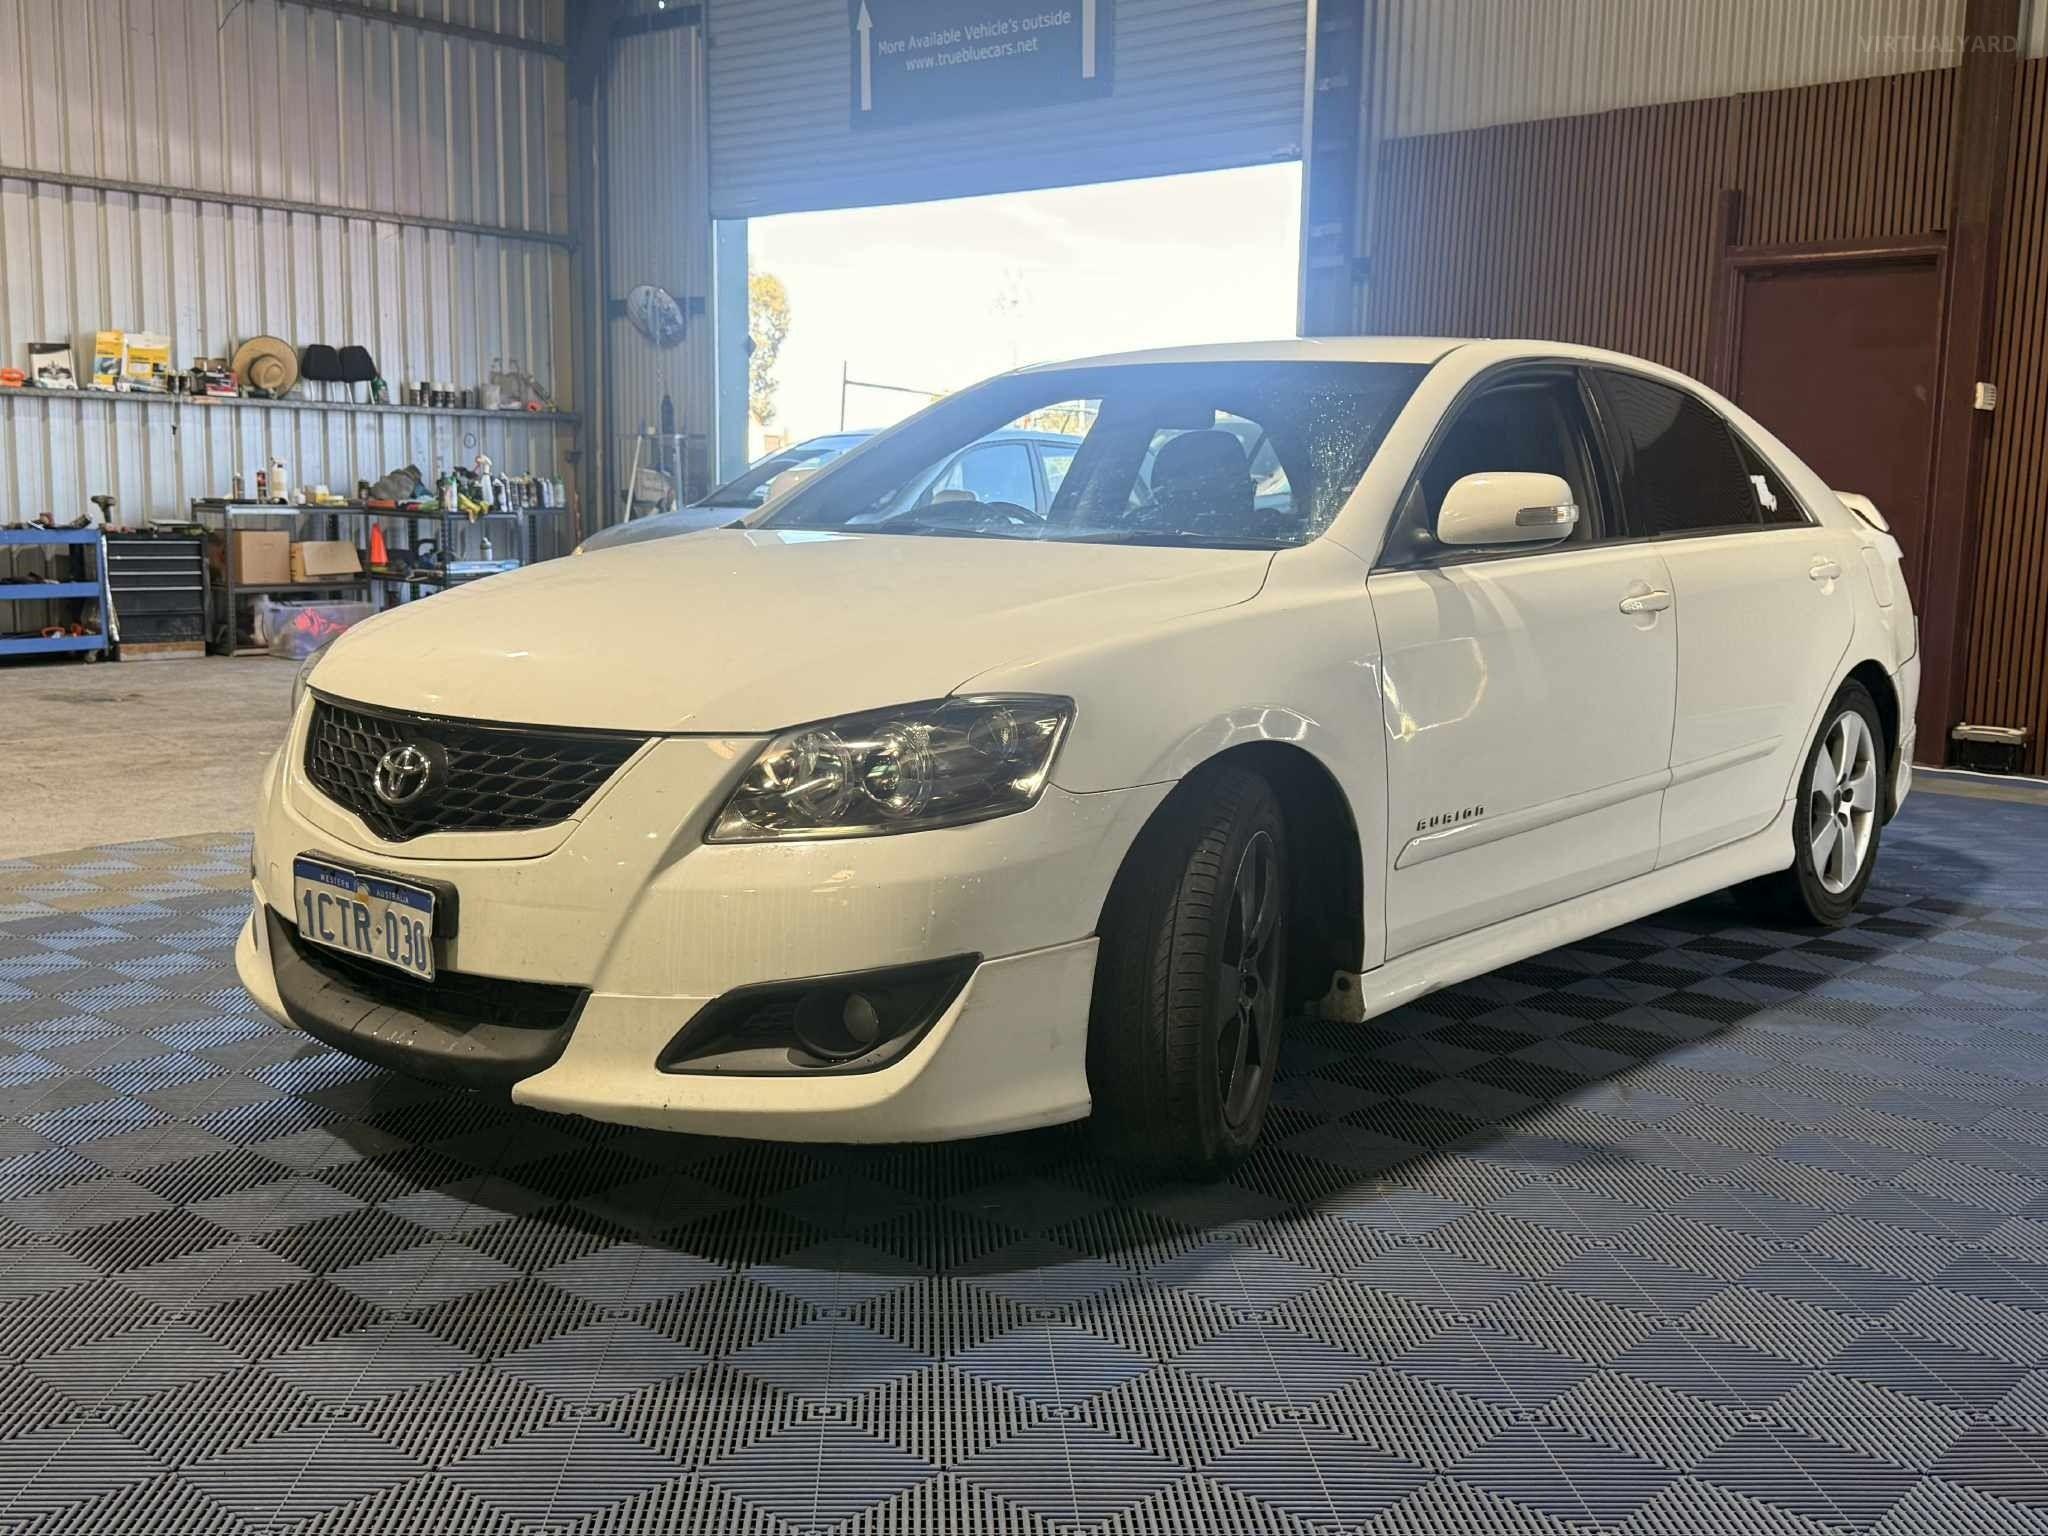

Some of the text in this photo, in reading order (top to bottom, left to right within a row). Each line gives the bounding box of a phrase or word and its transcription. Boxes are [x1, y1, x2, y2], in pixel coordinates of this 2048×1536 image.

[877, 10, 1072, 56] More Available Vehicle's outside
[905, 37, 1039, 71] www.truebluecars.net
[320, 874, 409, 904] WESTERN AUSTRALIA
